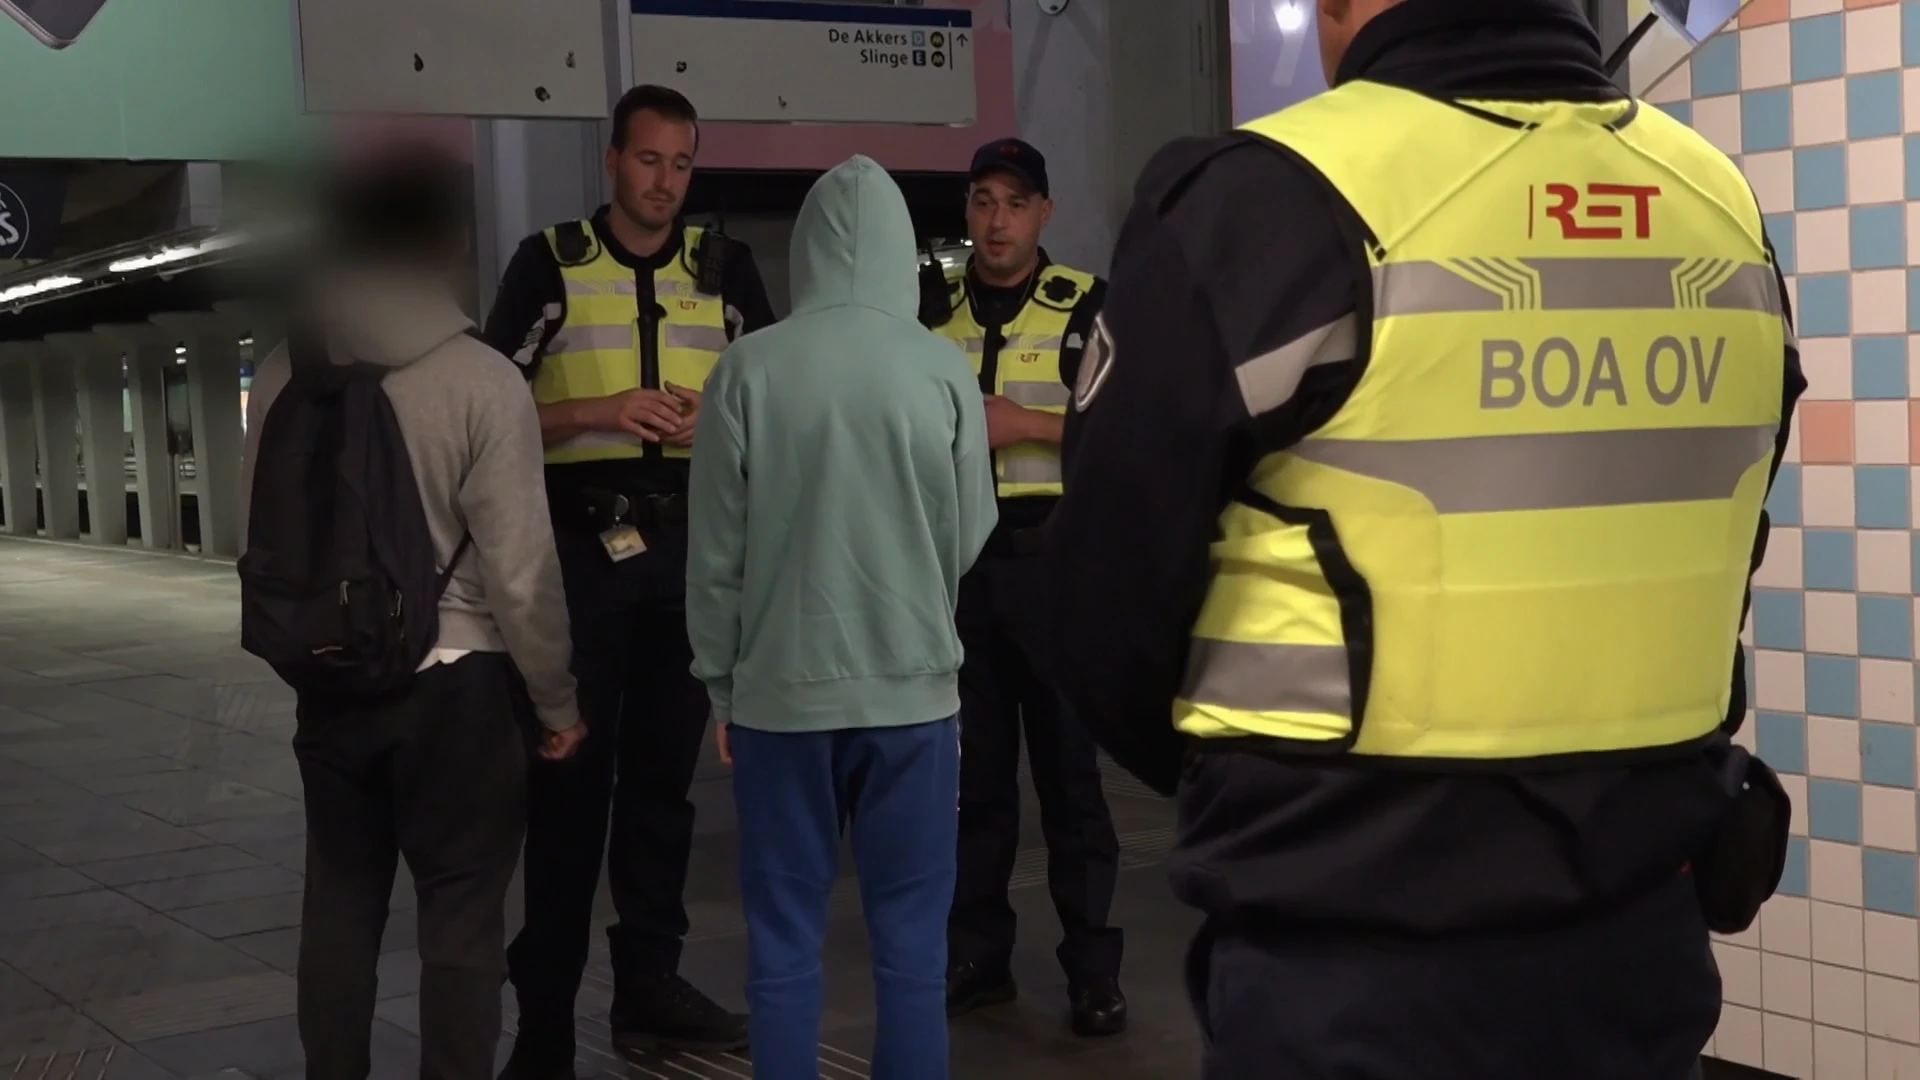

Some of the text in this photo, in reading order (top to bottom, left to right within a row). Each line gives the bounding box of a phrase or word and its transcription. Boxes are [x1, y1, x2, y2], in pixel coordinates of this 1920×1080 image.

[828, 28, 849, 43] De
[854, 29, 908, 45] Akkers
[860, 49, 908, 68] Slinge
[1545, 183, 1662, 239] RET
[1480, 335, 1726, 409] BOA OV
